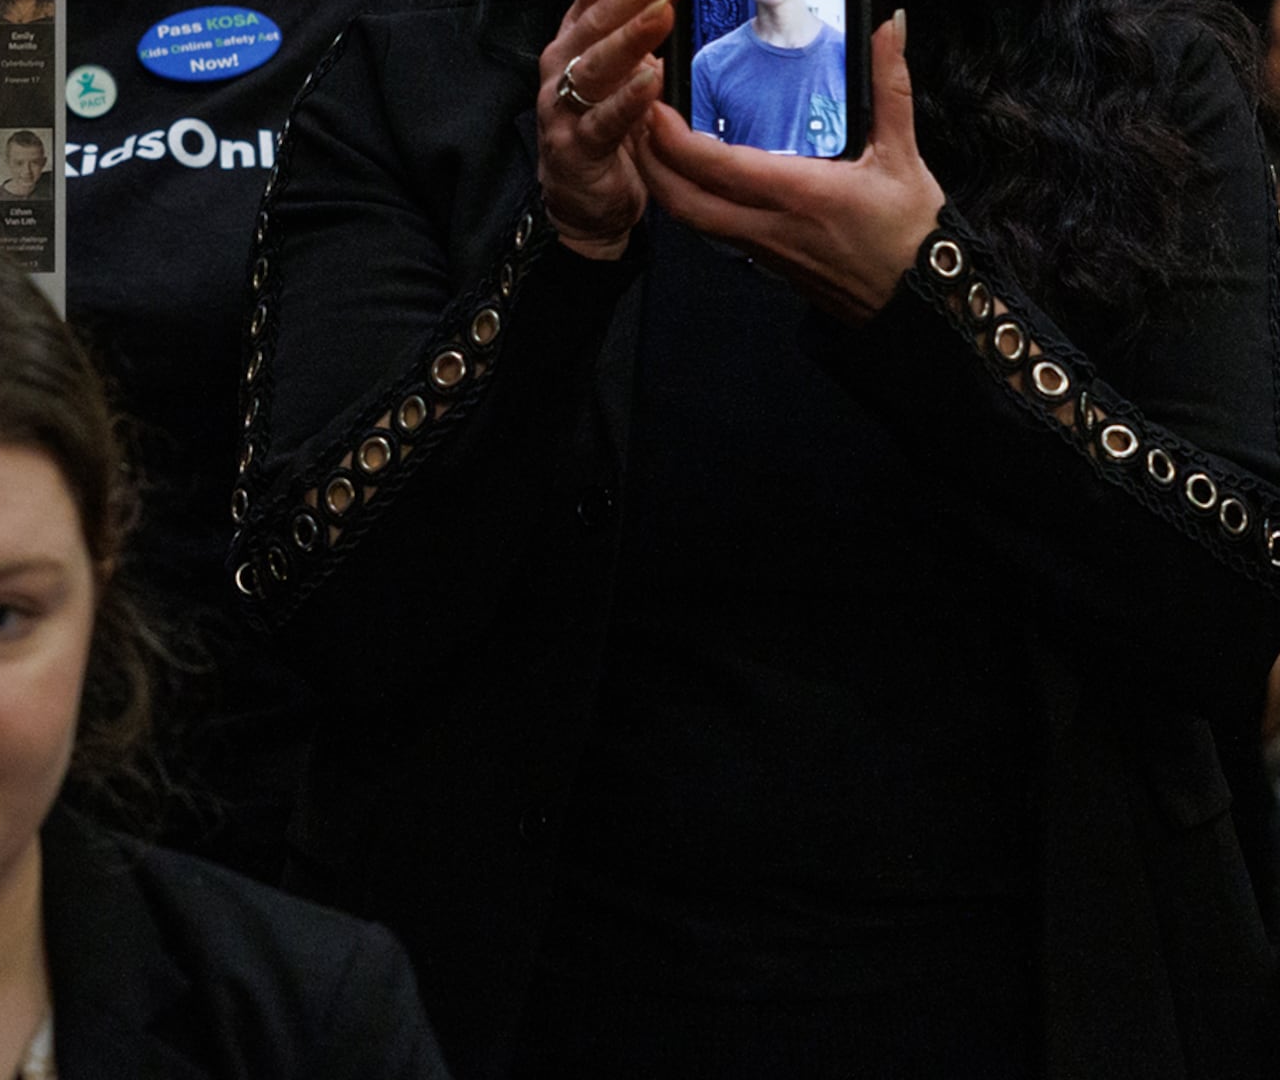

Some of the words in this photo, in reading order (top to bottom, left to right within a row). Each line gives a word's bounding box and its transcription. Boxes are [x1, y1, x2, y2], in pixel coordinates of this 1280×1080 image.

[157, 22, 202, 39] Pass
[206, 12, 259, 30] KOSA
[140, 46, 169, 59] Kids
[170, 40, 213, 54] Online
[215, 34, 255, 48] Safety
[258, 31, 280, 41] Act
[189, 53, 239, 73] Now!
[80, 95, 106, 109] PACT
